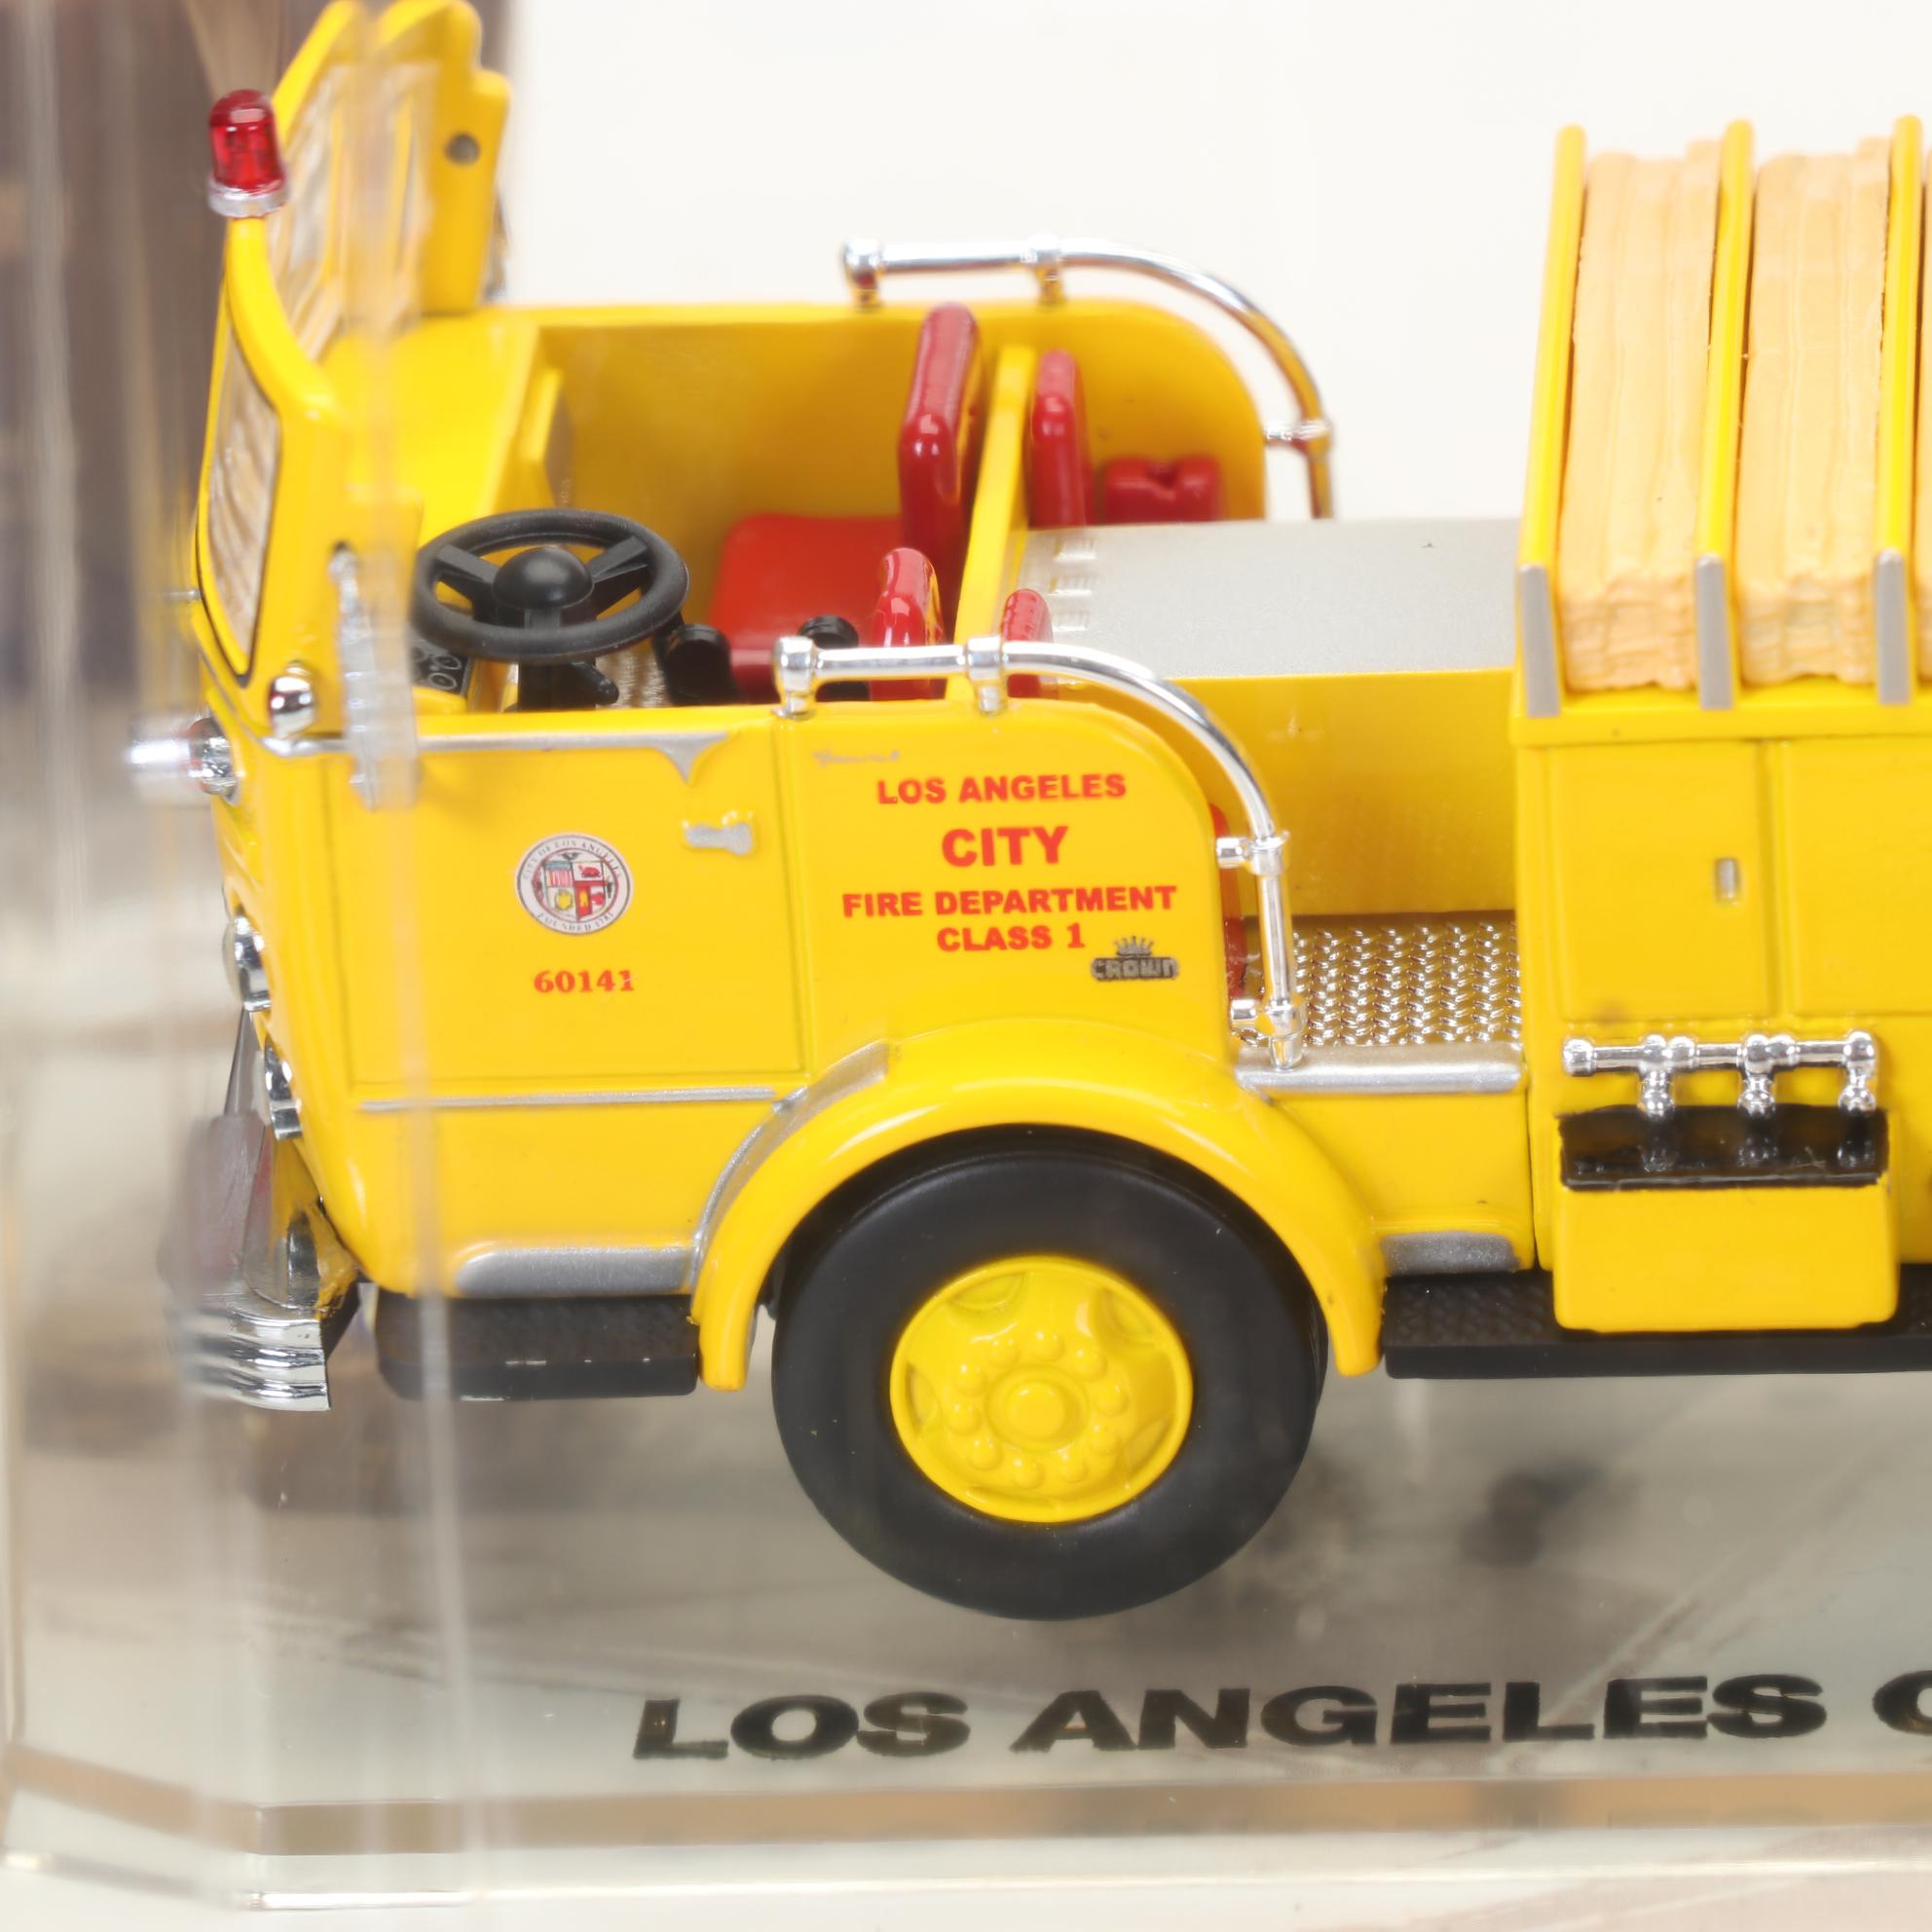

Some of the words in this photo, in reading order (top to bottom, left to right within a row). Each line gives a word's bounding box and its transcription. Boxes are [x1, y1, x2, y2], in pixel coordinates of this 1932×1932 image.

[877, 777, 947, 805] LOS
[958, 773, 1127, 803] ANGELES
[941, 825, 1068, 868] CITY
[841, 891, 923, 918] FIRE
[934, 884, 1178, 916] DEPARTMENT
[937, 924, 1054, 952] CLASS
[1067, 922, 1086, 949] 1
[534, 969, 633, 993] 60141
[634, 1691, 969, 1760] LOS
[1011, 1675, 1827, 1754] ANGELES
